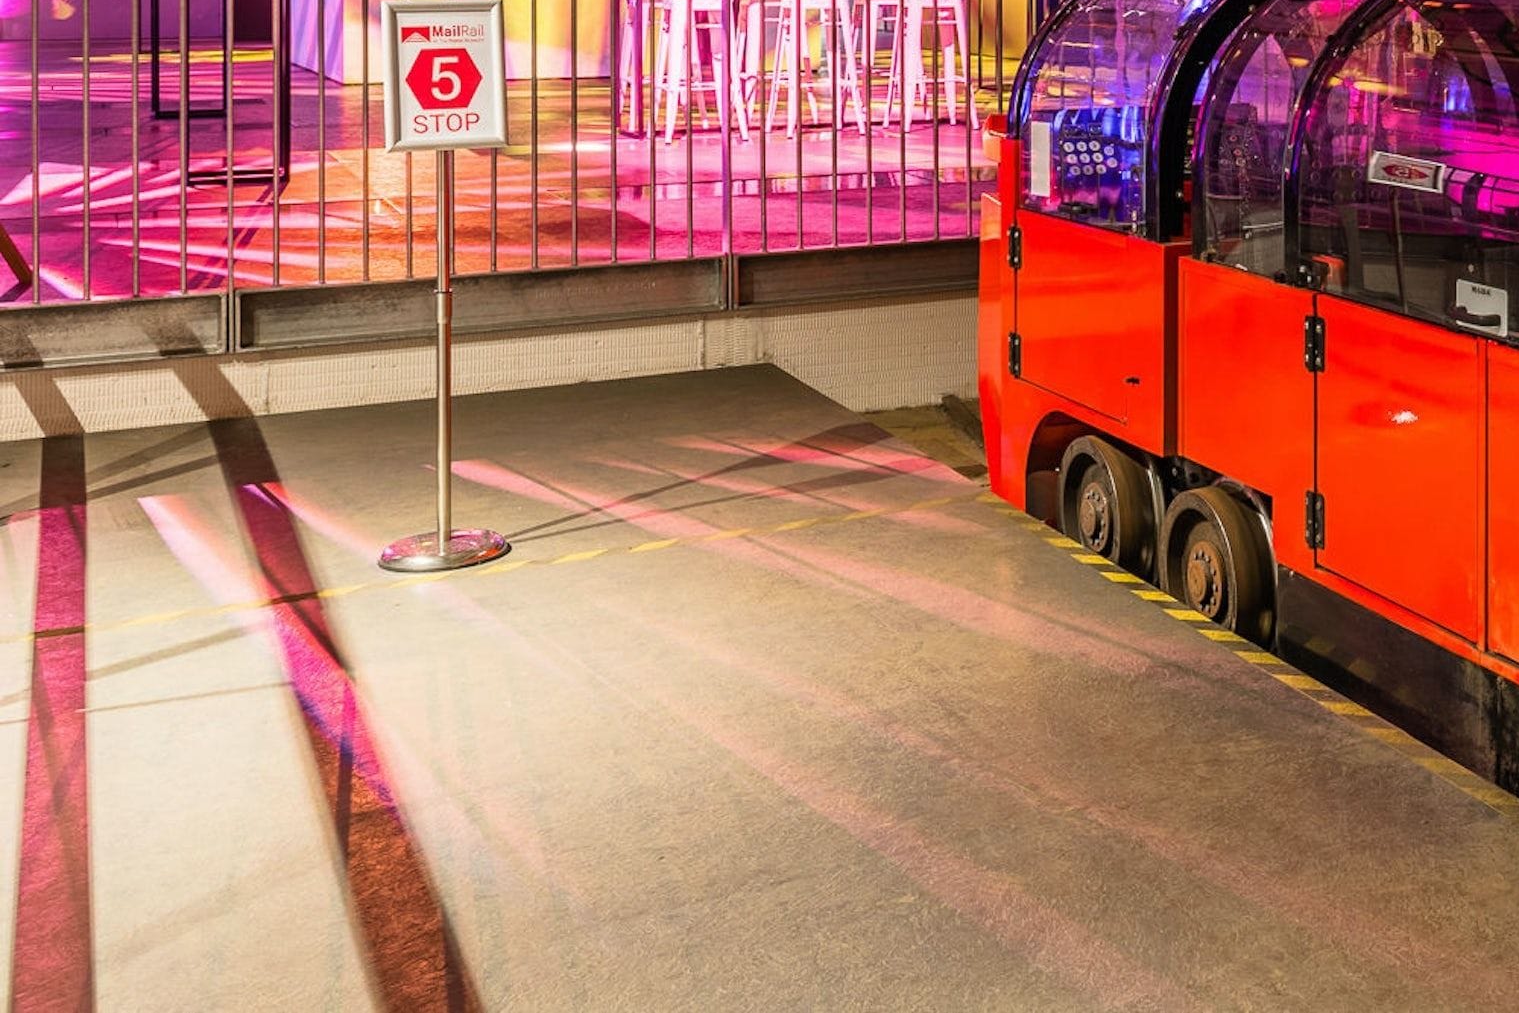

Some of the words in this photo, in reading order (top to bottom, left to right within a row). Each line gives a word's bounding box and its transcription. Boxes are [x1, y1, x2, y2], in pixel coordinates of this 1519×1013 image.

[432, 25, 484, 37] MailRail
[431, 56, 462, 102] 5
[413, 112, 480, 134] STOP
